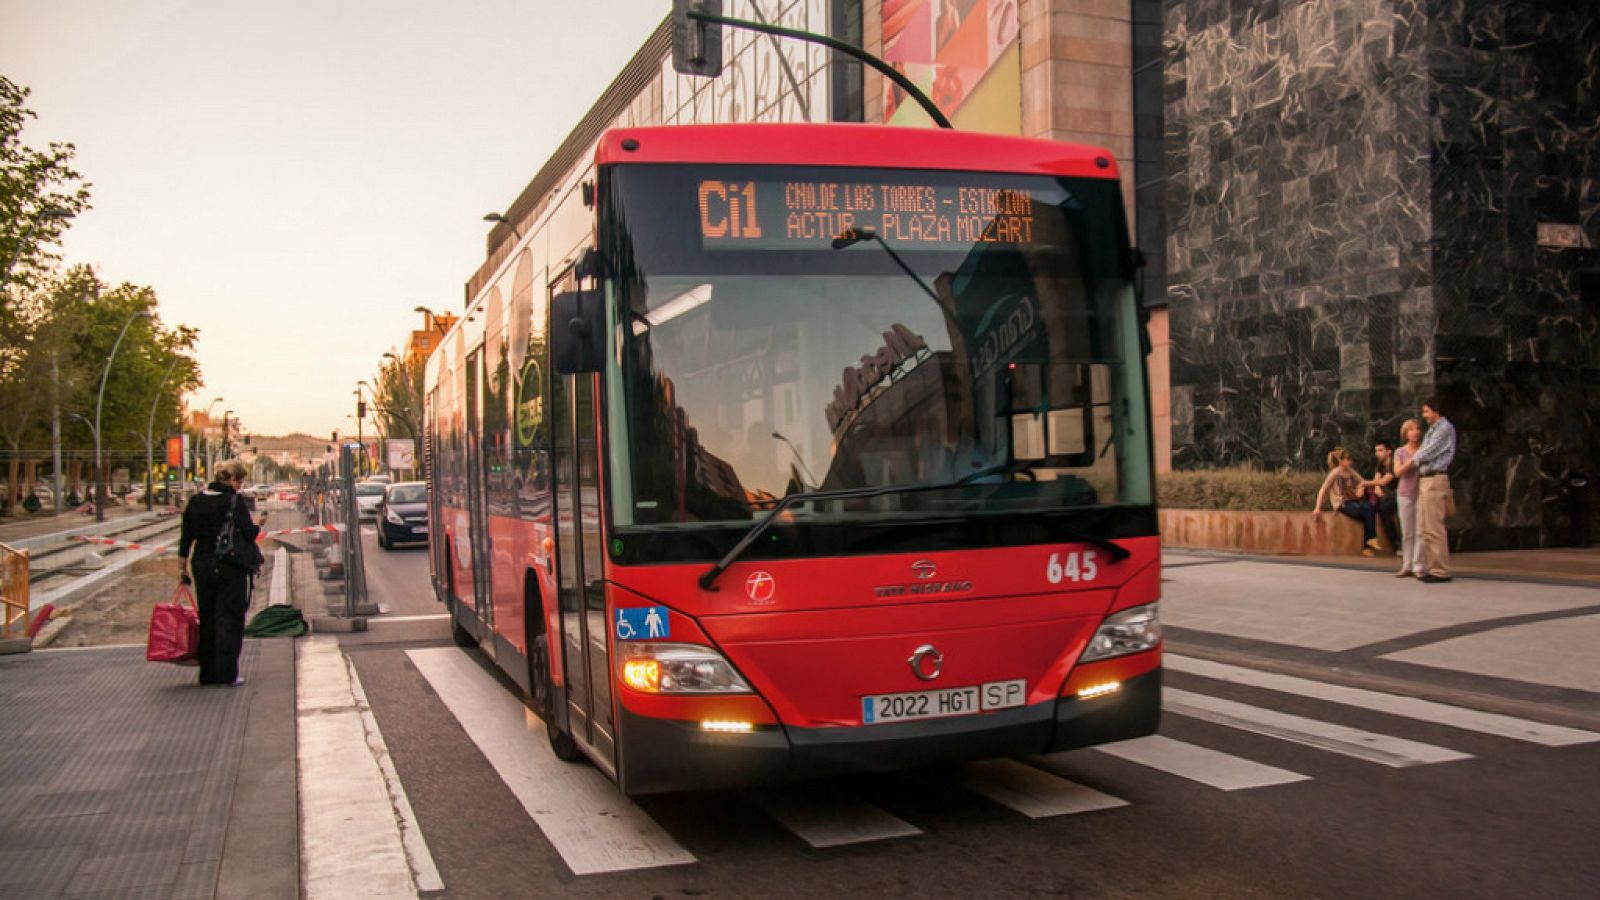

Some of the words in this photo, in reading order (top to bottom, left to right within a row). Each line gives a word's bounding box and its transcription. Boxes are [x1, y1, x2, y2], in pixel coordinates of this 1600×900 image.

[698, 180, 762, 238] Ci1
[845, 183, 875, 211] LAS
[881, 184, 937, 212] TORRES
[959, 188, 1034, 215] ESTACION
[787, 212, 856, 239] ACTUR
[882, 214, 951, 241] PLAZA
[956, 215, 1034, 243] MOZART
[1046, 551, 1097, 583] 645
[880, 695, 929, 718] 2022
[938, 690, 975, 713] HGT
